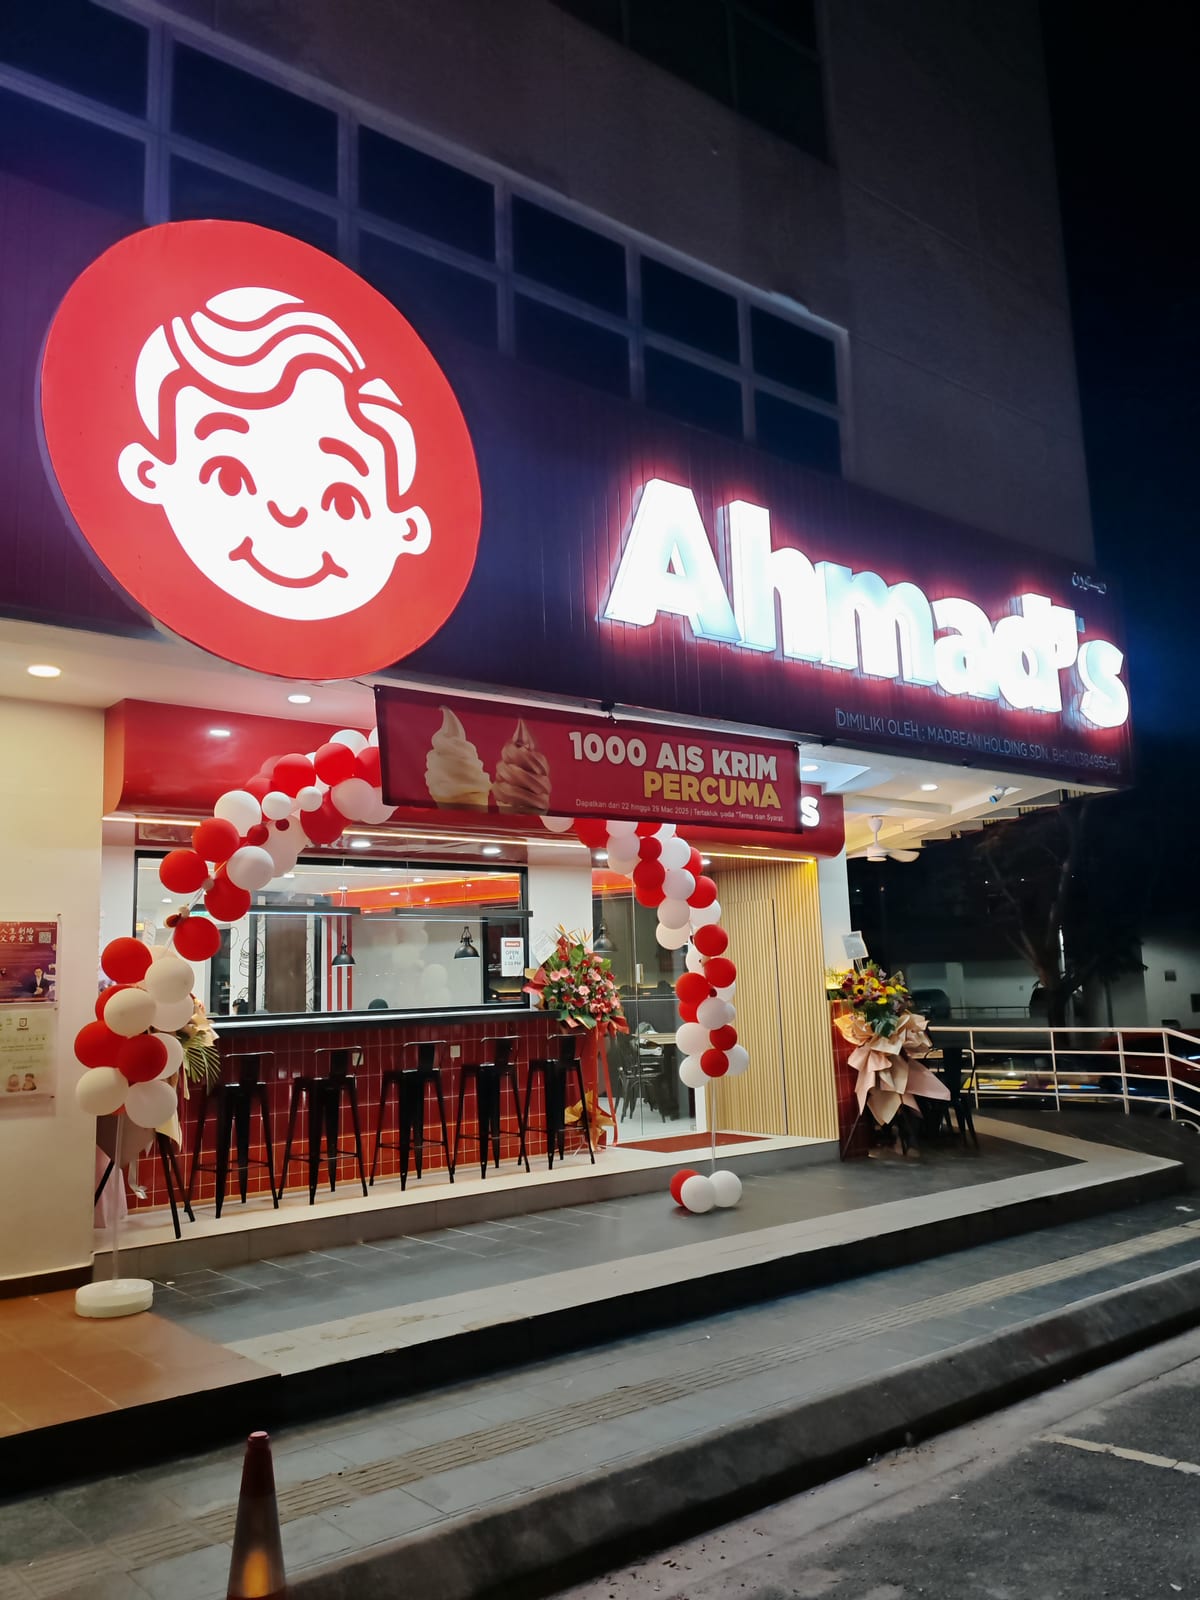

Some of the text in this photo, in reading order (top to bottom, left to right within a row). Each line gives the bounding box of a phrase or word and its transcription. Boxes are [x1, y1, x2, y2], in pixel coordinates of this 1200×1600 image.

[598, 478, 1129, 728] Ahmad's
[569, 731, 777, 781] 1000 AIS KRIM
[836, 708, 885, 733] DIMILIKI
[888, 719, 919, 738] OLEH
[927, 726, 981, 748] MADBEAN
[984, 736, 1027, 757] HOLDING
[621, 802, 630, 810] 22
[660, 806, 673, 814] Mac
[674, 807, 689, 815] 2025
[643, 770, 781, 809] PERCUMA
